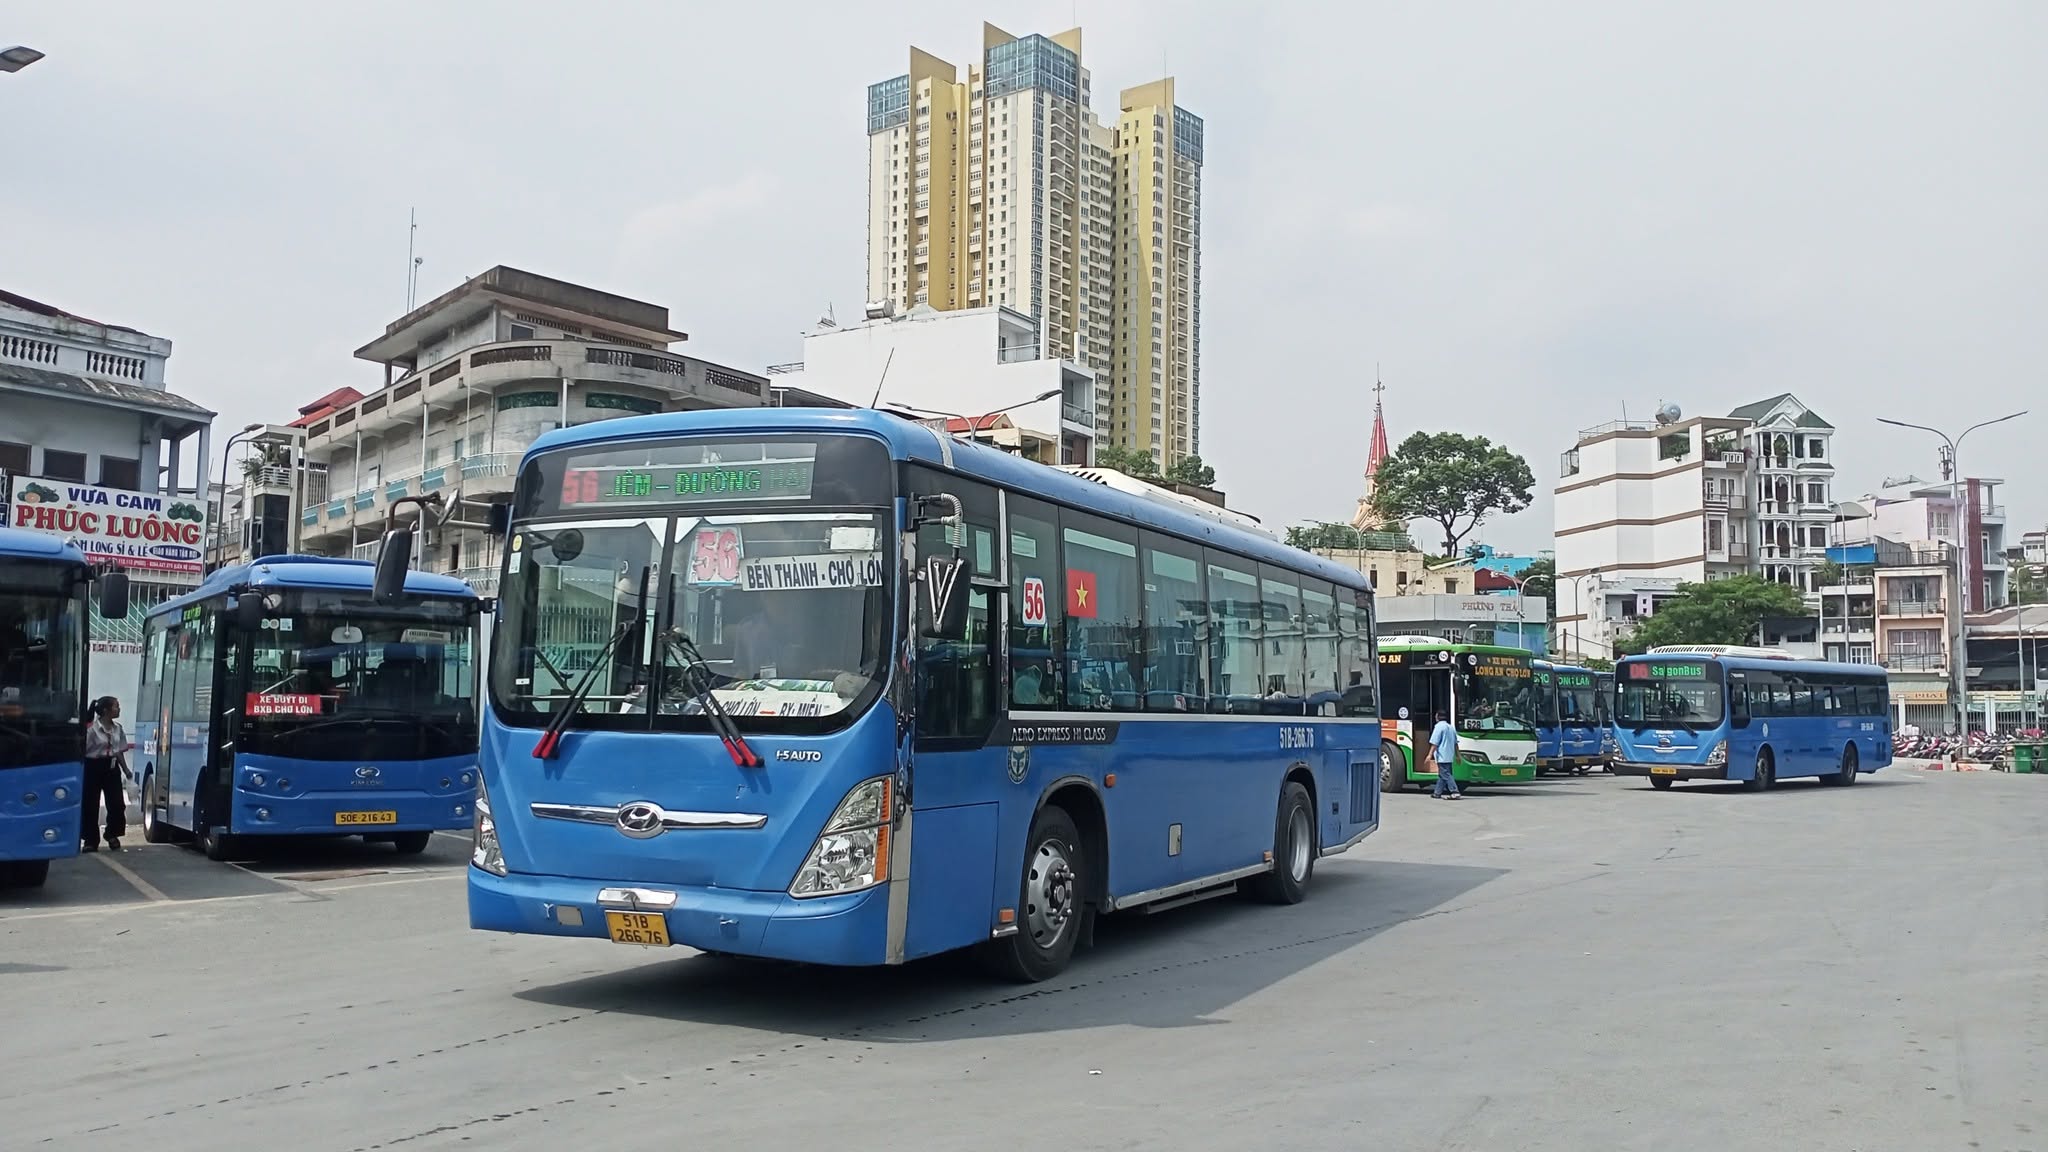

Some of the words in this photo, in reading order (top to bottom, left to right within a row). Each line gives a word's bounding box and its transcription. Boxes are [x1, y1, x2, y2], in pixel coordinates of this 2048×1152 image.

[68, 487, 108, 506] VỰA
[116, 493, 161, 512] CAM
[15, 503, 98, 534] PHÚC
[105, 513, 201, 545] LUÔNG
[91, 540, 113, 554] LONG
[128, 545, 136, 556] &
[693, 530, 737, 581] 56
[746, 558, 773, 588] BẾN
[775, 556, 818, 588] THÀNH
[829, 555, 854, 587] CHỢ
[1025, 582, 1043, 620] 56
[1388, 654, 1401, 663] AN
[1475, 665, 1494, 676] LONG
[1652, 665, 1702, 677] SagonBus
[259, 695, 271, 703] XE
[253, 705, 272, 714] BXB
[1011, 727, 1035, 742] AERO
[1037, 727, 1071, 741] EXPRESS
[1083, 727, 1106, 741] CLASS
[622, 914, 648, 928] 51B
[616, 928, 663, 944] 266.76
